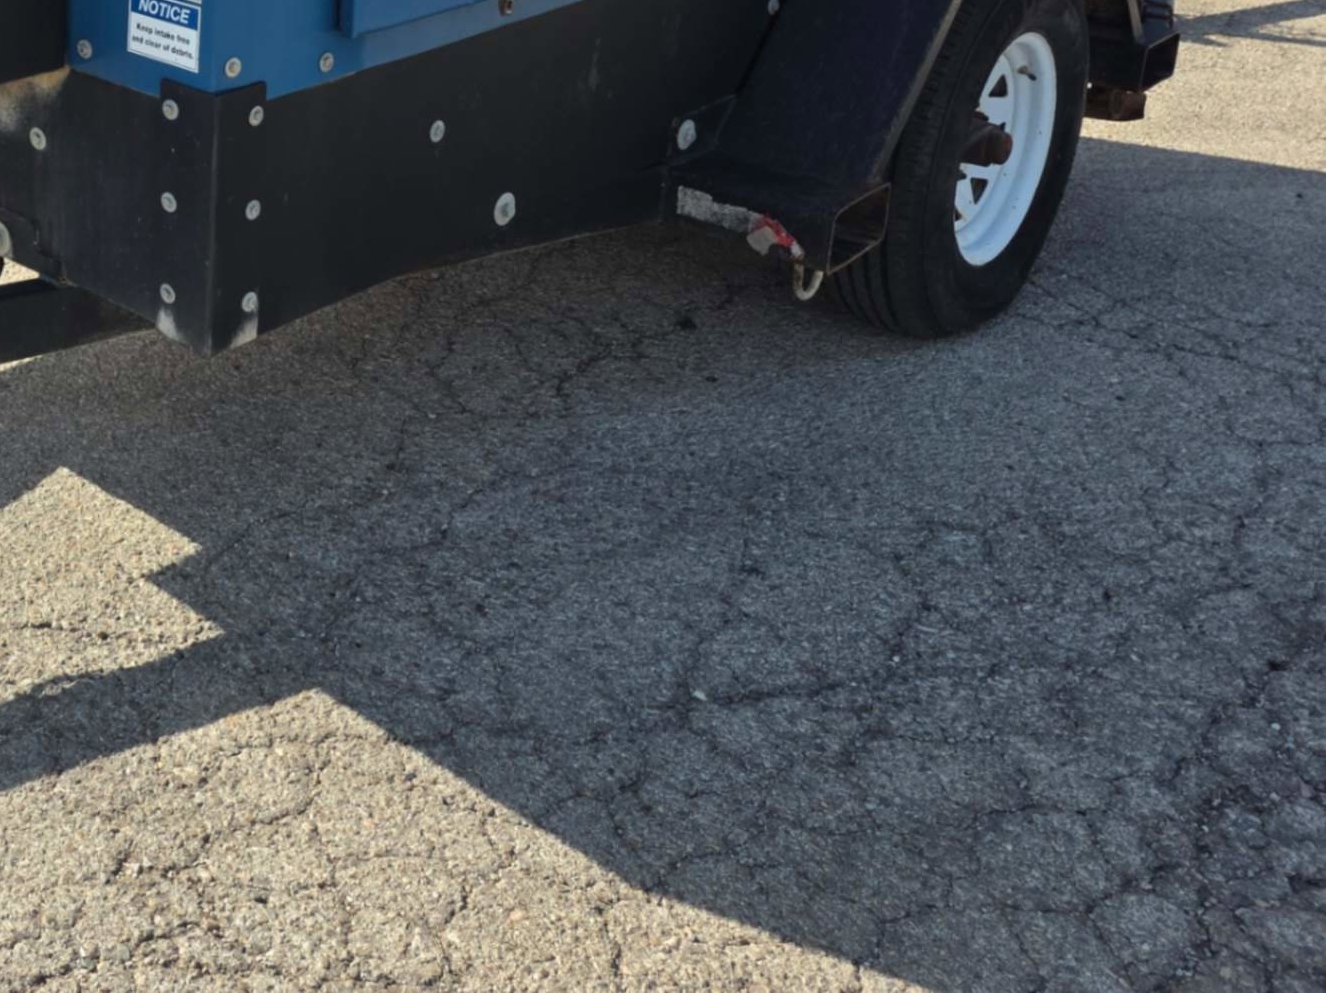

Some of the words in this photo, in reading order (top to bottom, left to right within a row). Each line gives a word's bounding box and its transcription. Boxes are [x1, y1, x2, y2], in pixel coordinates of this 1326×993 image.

[136, 22, 153, 35] Keep
[154, 27, 175, 41] intake
[176, 34, 190, 45] free
[132, 35, 144, 44] and
[145, 38, 162, 49] clear
[171, 46, 194, 60] debris.
